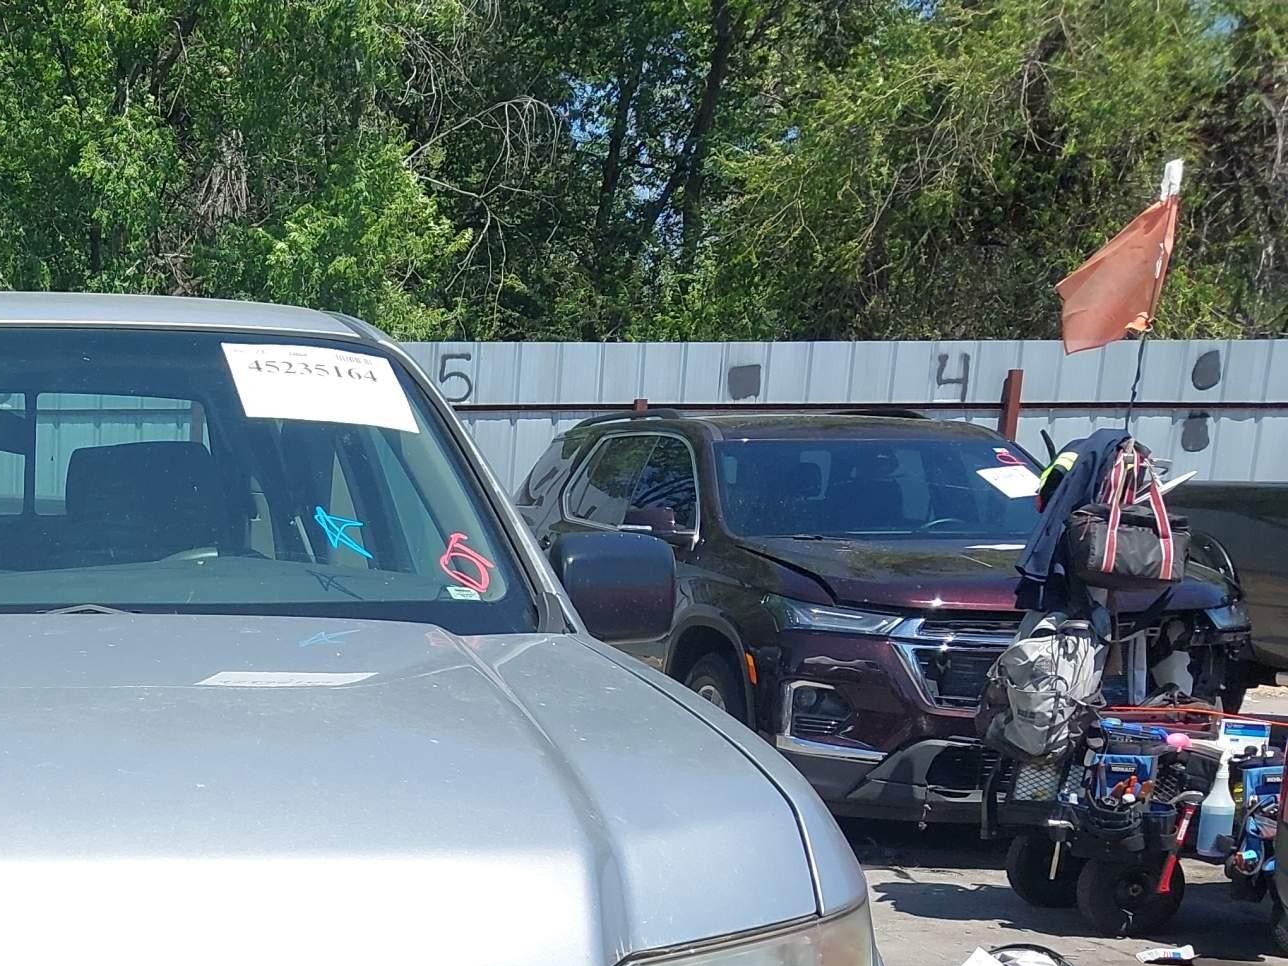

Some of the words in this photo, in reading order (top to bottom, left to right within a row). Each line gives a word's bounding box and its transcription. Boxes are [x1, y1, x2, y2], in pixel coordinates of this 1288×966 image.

[248, 360, 377, 383] 45235164
[439, 352, 473, 402] 5
[936, 352, 970, 402] 4
